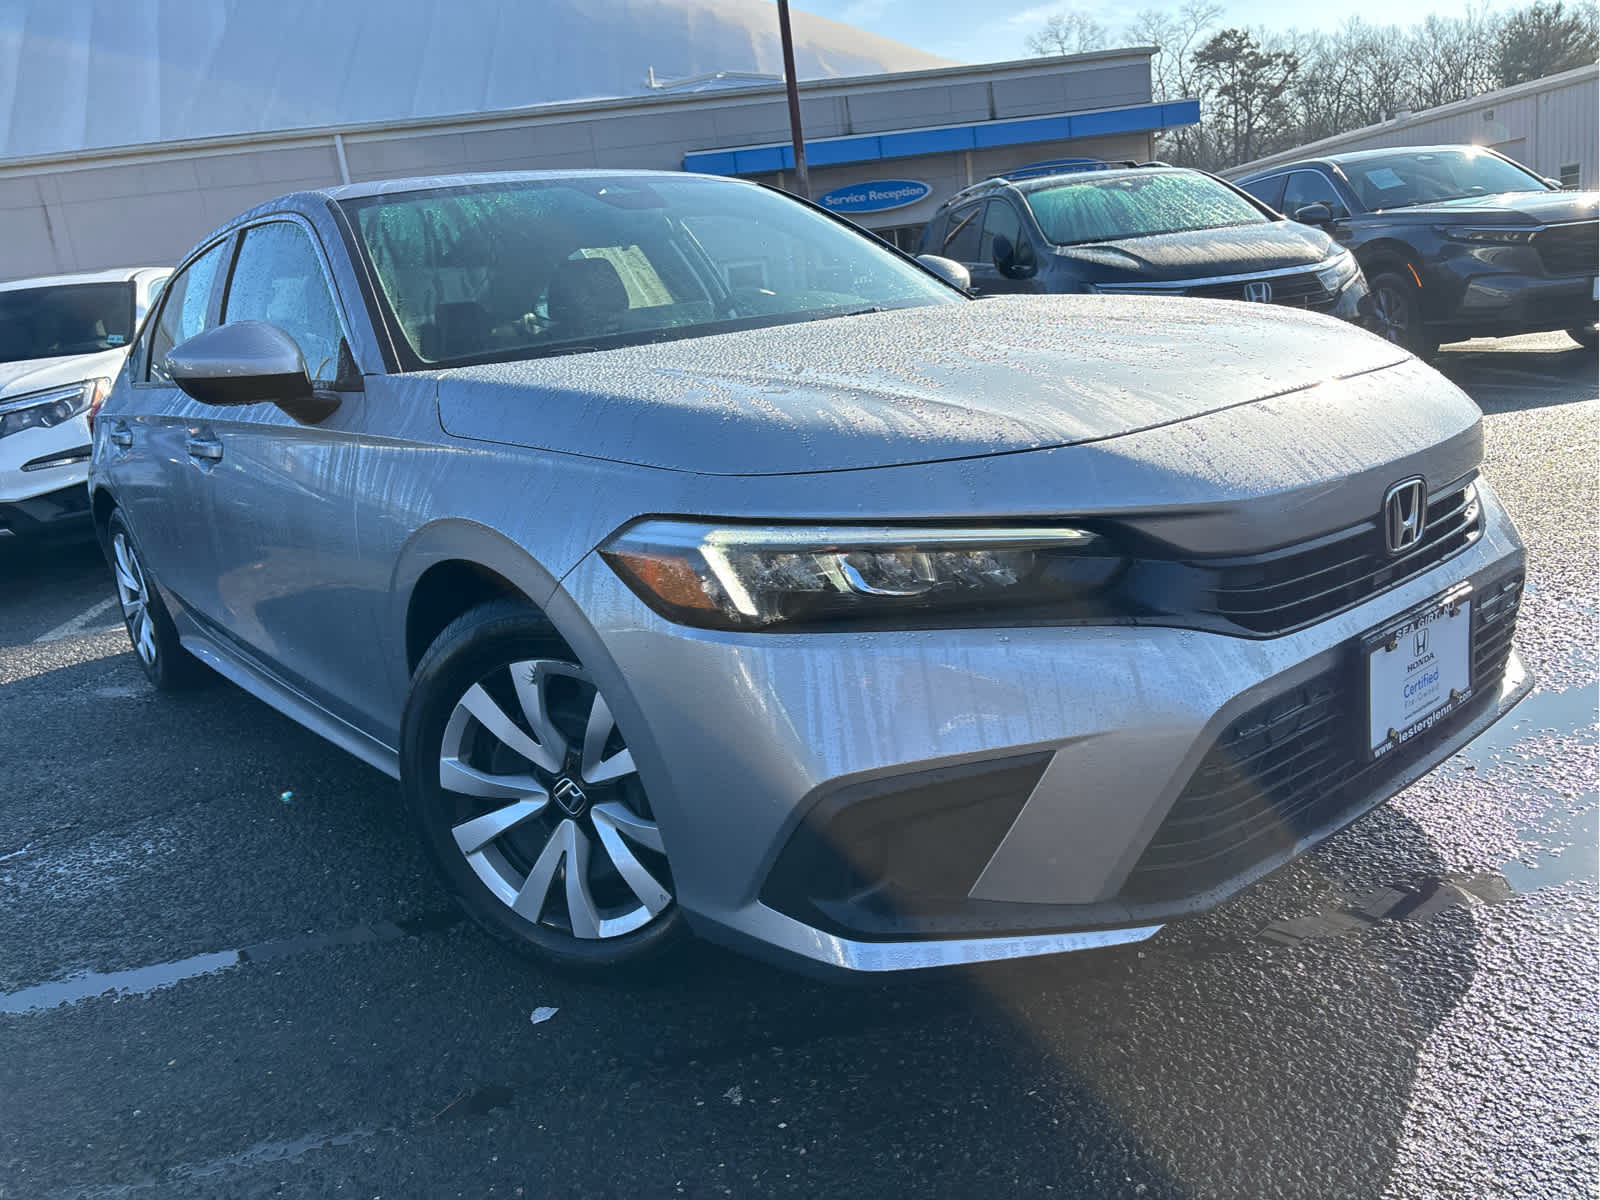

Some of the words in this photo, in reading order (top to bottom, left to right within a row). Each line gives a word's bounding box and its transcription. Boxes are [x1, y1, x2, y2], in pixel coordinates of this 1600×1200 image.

[825, 193, 866, 206] Service
[868, 186, 924, 201] Reception
[1395, 624, 1415, 640] SEA
[1407, 653, 1434, 673] HONDA
[1403, 665, 1439, 698] Certified
[1399, 704, 1452, 743] lesterglenn
